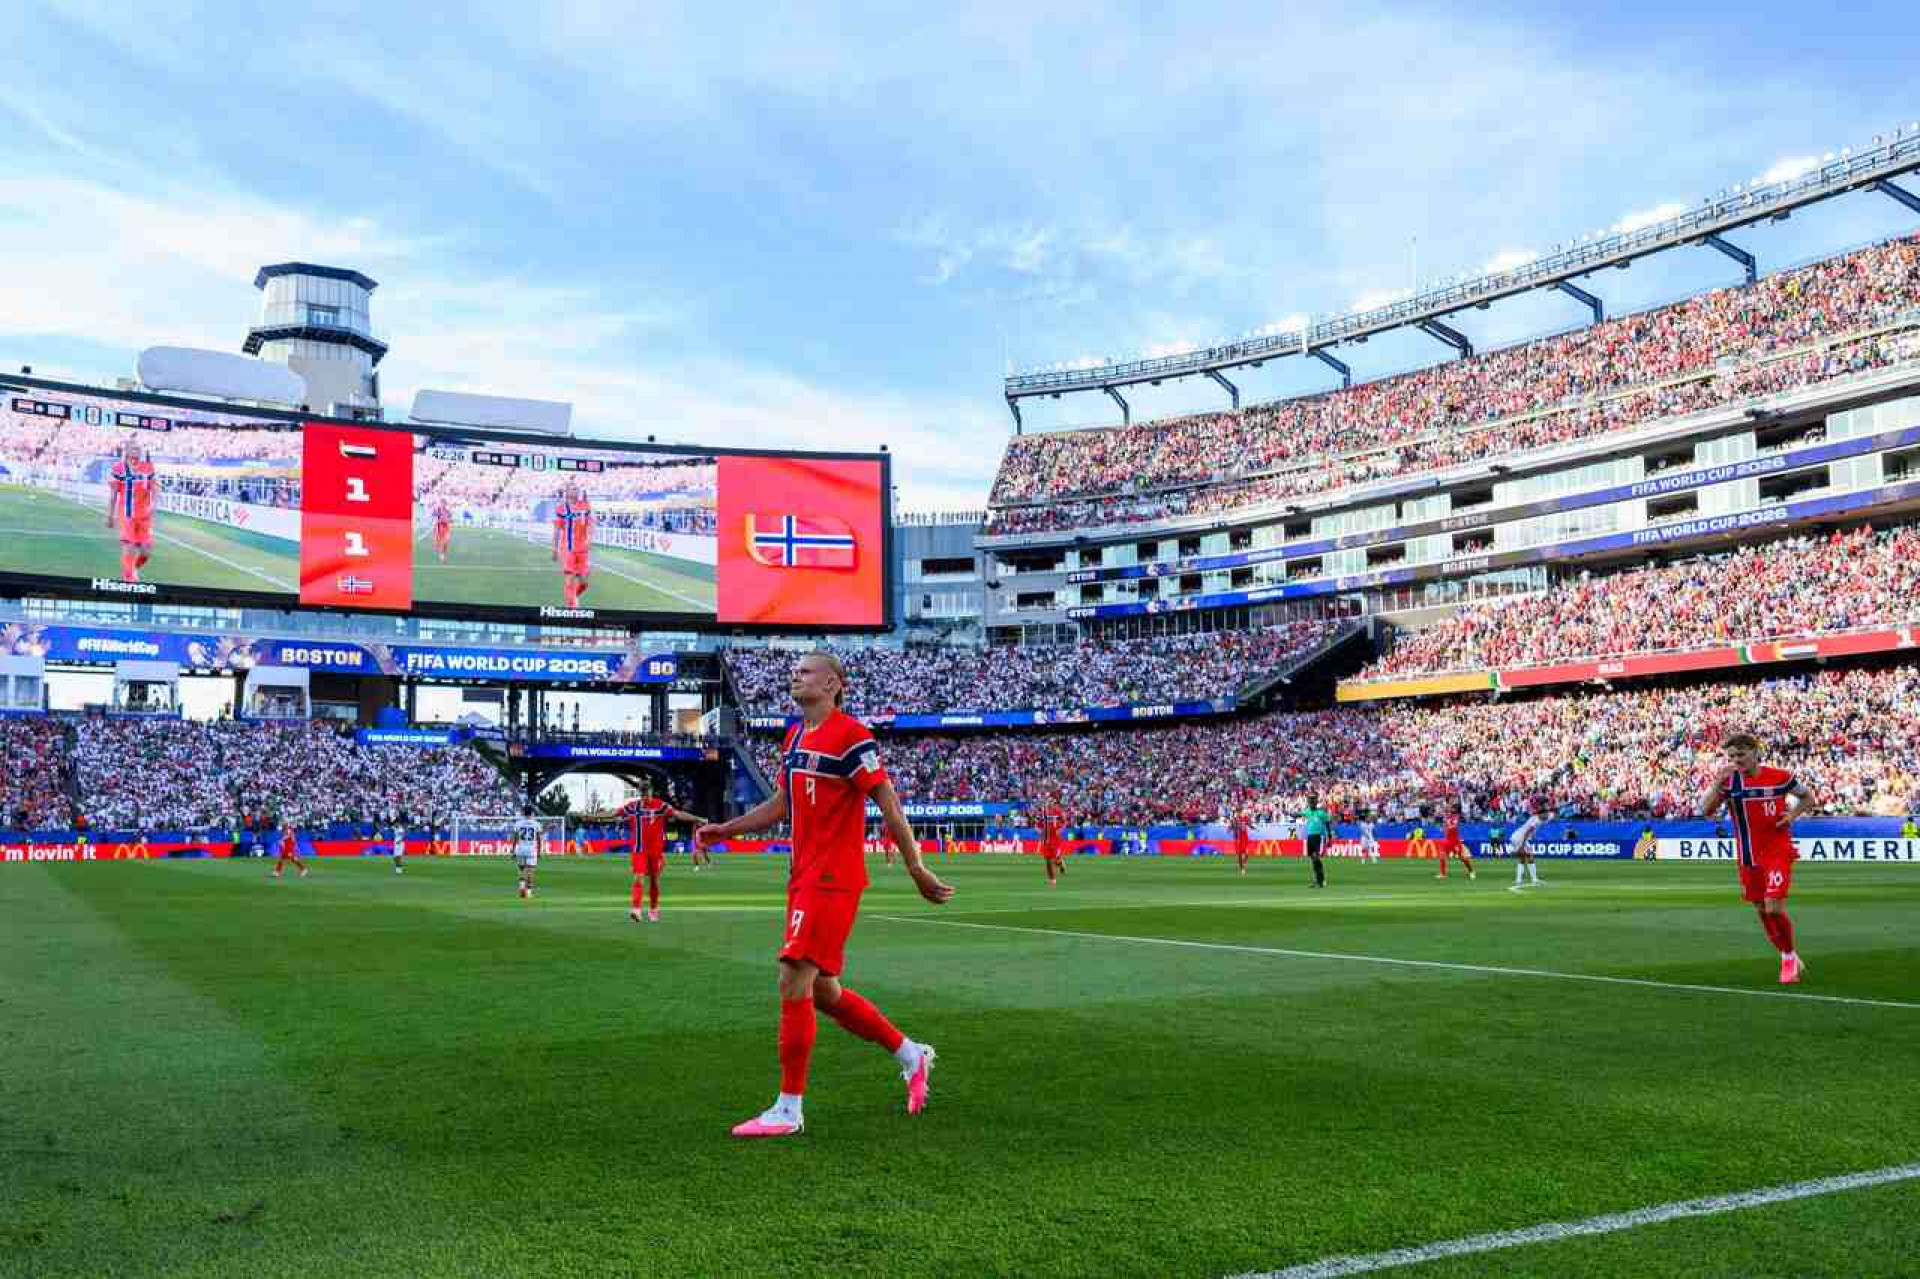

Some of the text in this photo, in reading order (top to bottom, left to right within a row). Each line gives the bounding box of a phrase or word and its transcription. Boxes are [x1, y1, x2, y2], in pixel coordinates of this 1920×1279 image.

[1632, 456, 1786, 497] FIFA WORLD CUP 2026
[347, 477, 370, 501] 1
[1632, 507, 1789, 544] FIFA WORLD CUP 2026
[345, 532, 369, 556] 1
[92, 577, 156, 595] Hisense
[540, 605, 595, 619] Hisense
[281, 647, 362, 666] BOSTON
[408, 653, 607, 673] FIFA WORLD CUP 2026
[806, 778, 816, 805] 9
[925, 804, 947, 815] CUP
[1763, 801, 1777, 816] 10
[520, 826, 535, 841] 23
[28, 843, 79, 860] lovin'
[84, 843, 97, 860] it
[1547, 843, 1572, 854] CUP
[1574, 842, 1615, 854] 2026
[1769, 870, 1784, 887] 10
[792, 910, 805, 937] 9
